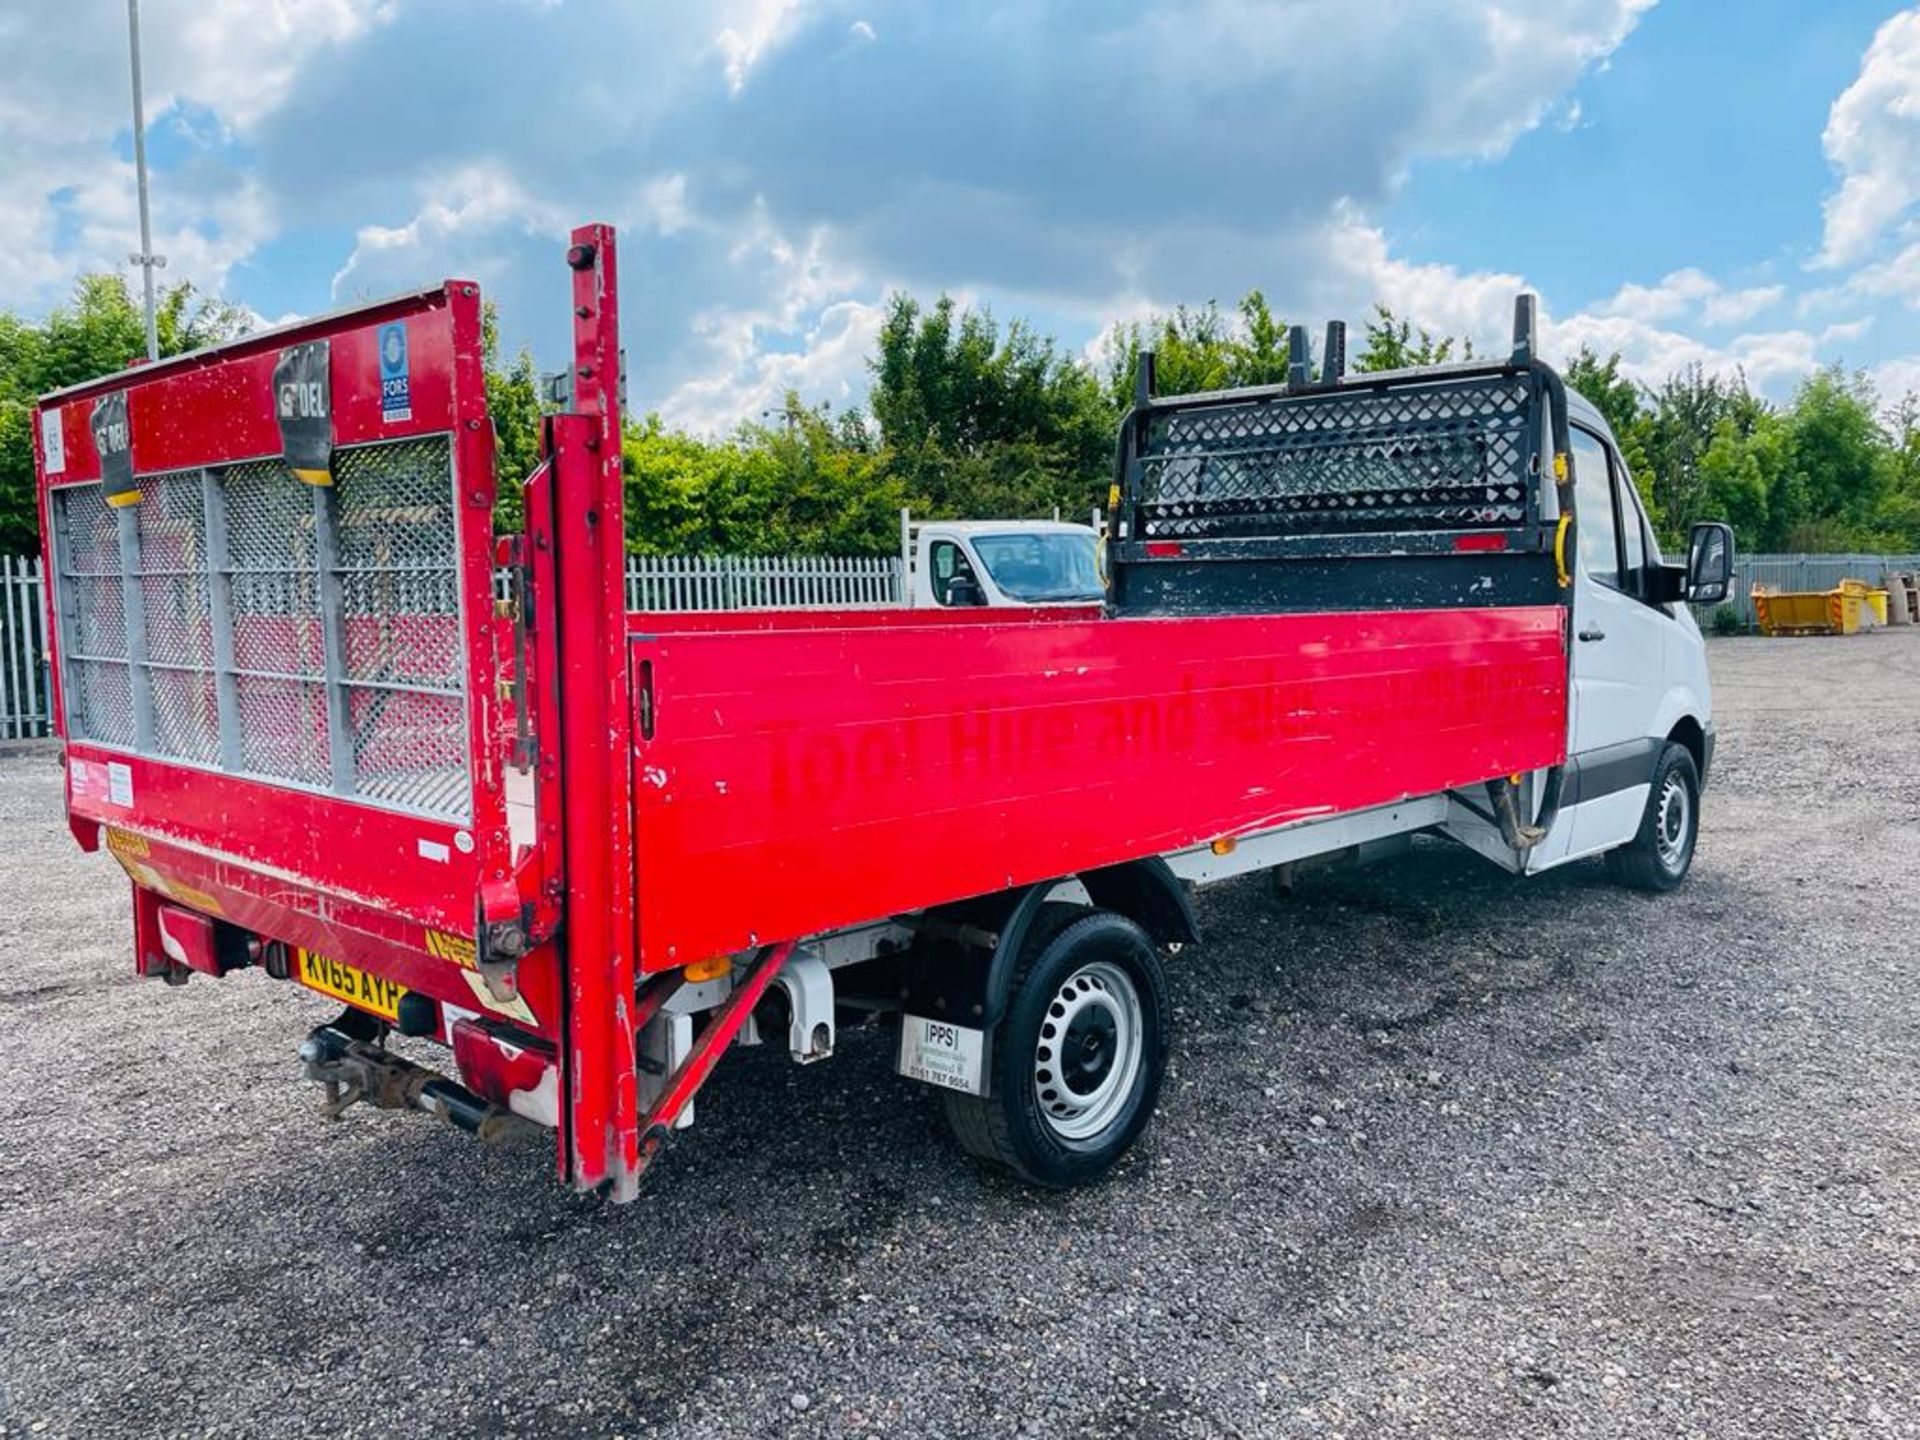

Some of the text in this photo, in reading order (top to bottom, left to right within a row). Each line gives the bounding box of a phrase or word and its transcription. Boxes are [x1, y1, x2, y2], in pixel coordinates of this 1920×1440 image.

[383, 379, 408, 396] FORS
[756, 703, 918, 809] Tool
[949, 696, 1077, 779] Hire
[1097, 673, 1194, 761] and
[306, 950, 355, 995] KV65
